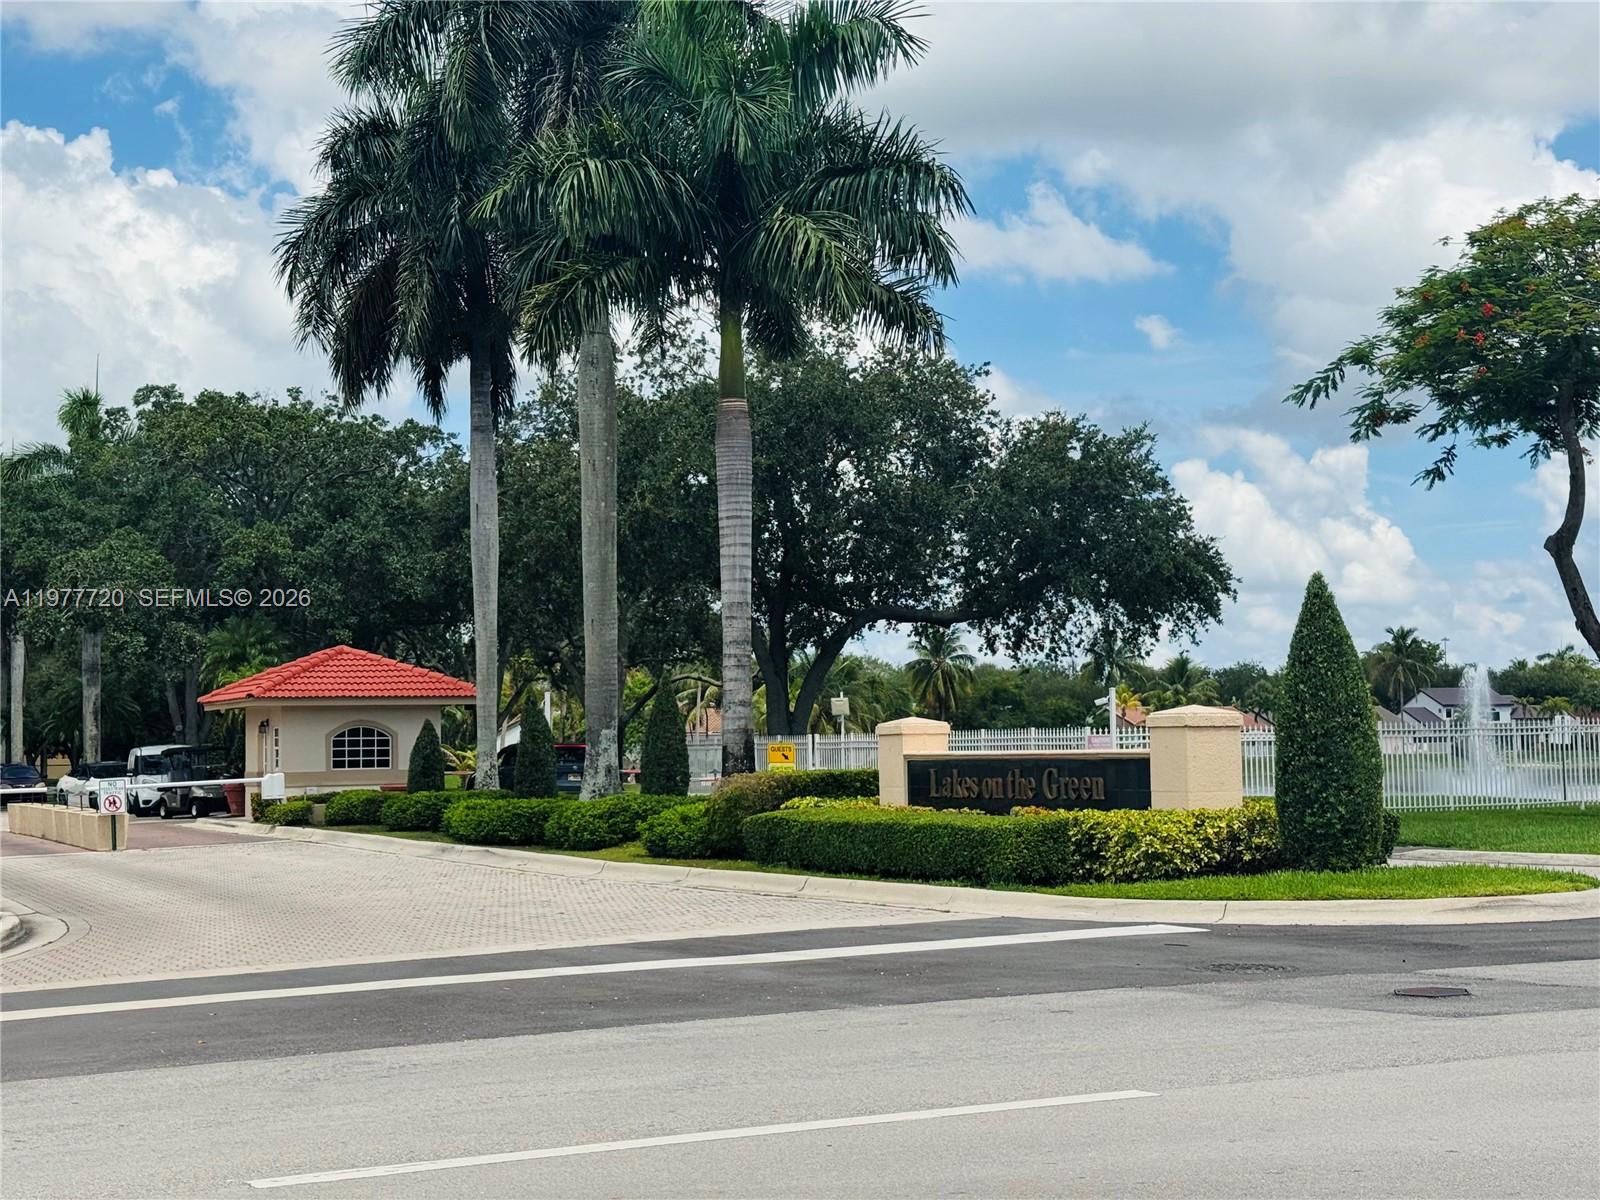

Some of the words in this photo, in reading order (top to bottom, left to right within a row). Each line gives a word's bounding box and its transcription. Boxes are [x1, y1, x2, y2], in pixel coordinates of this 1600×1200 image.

[929, 767, 979, 799] Lakes
[982, 776, 1004, 799] on
[1007, 768, 1036, 799] the
[1042, 767, 1106, 801] Green
